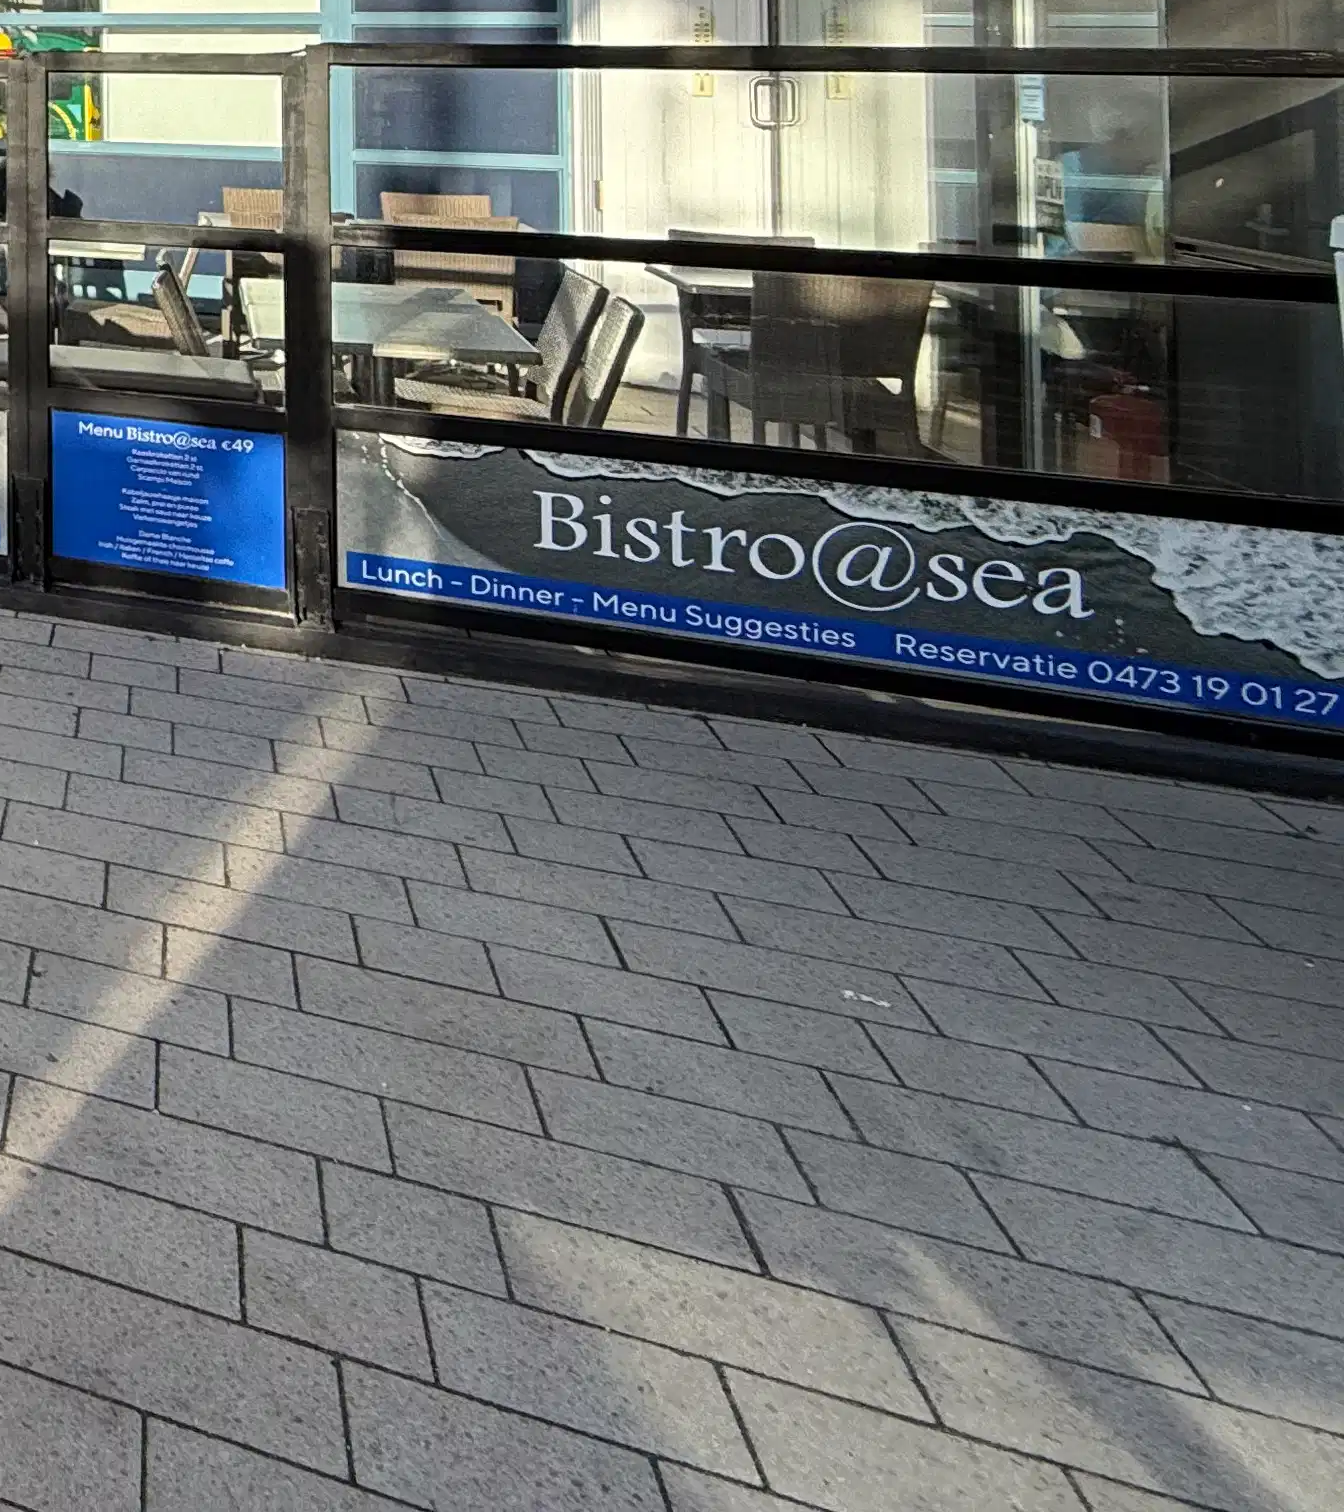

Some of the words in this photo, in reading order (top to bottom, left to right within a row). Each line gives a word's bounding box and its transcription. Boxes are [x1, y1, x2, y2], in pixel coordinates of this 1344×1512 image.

[78, 420, 124, 439] Menu
[127, 426, 216, 451] Bistro@sea
[532, 489, 1095, 619] Bistro@sea
[361, 559, 443, 590] Lunch
[471, 575, 565, 606] Dinner
[592, 591, 677, 624] Menu
[685, 604, 857, 649] Suggesties
[895, 633, 1078, 681] Reservatie
[1087, 660, 1181, 695] 0473
[1191, 674, 1230, 701] 19
[1241, 681, 1283, 710] 01
[1294, 688, 1340, 716] 27
